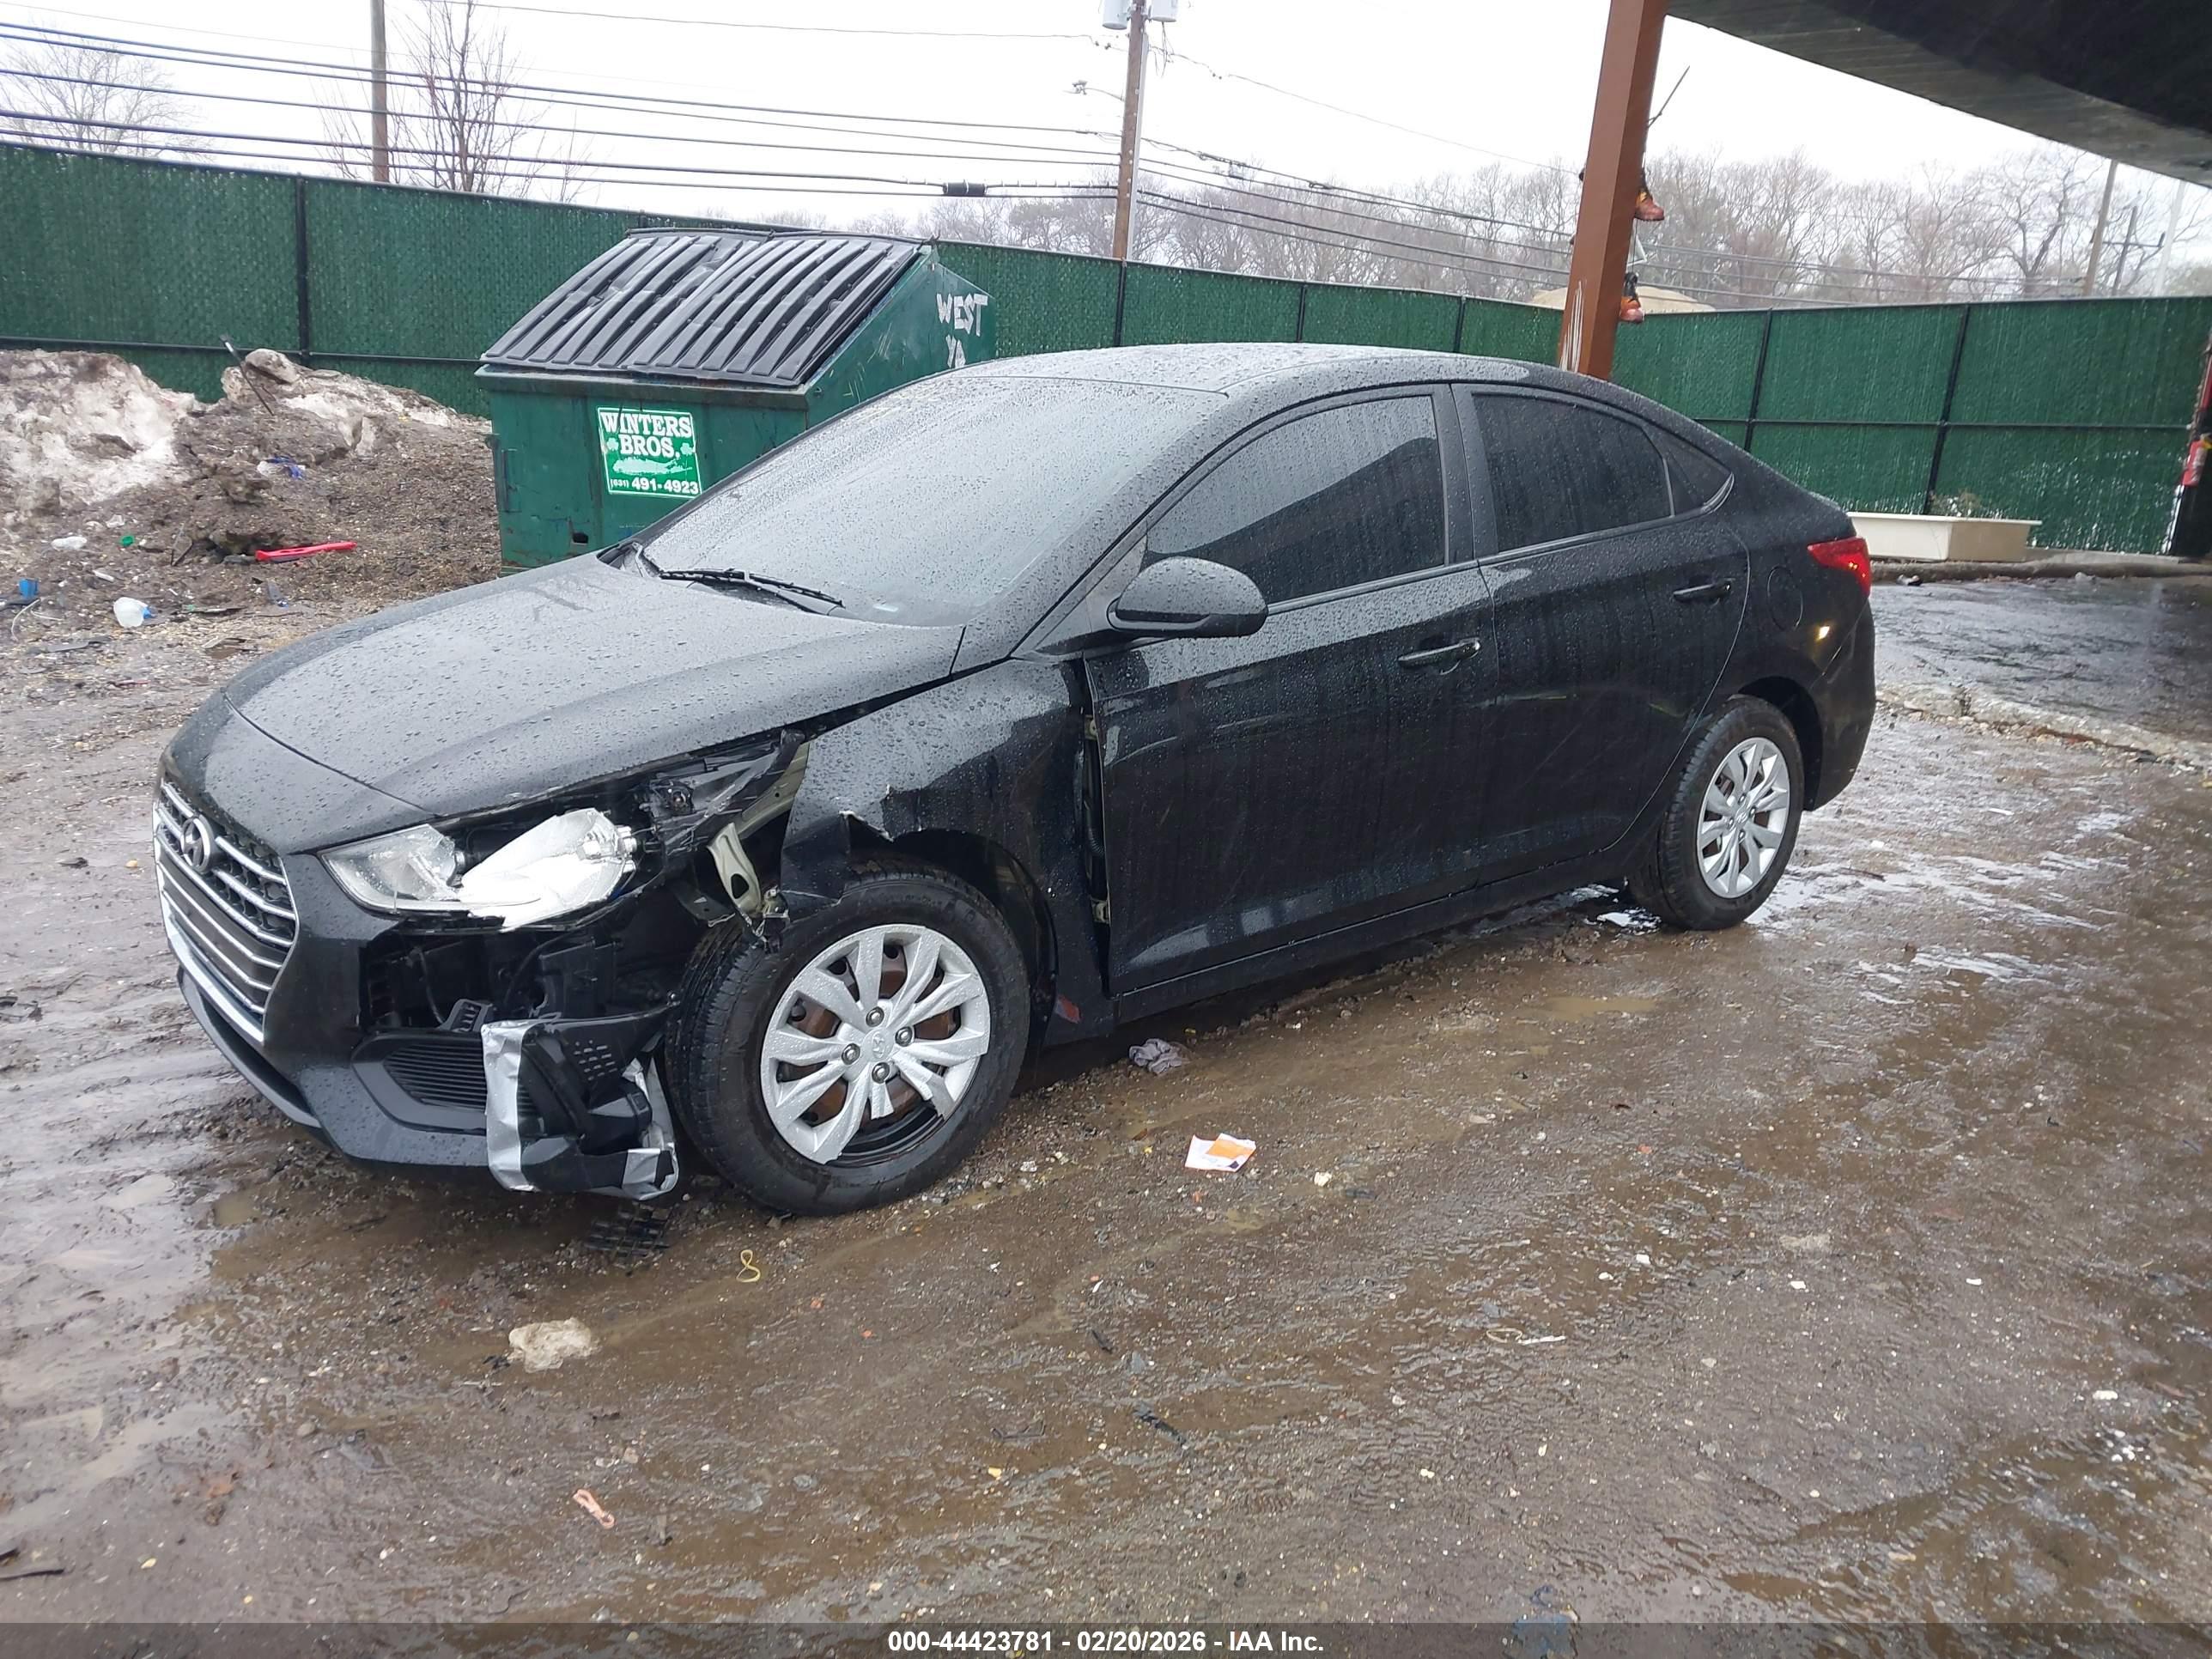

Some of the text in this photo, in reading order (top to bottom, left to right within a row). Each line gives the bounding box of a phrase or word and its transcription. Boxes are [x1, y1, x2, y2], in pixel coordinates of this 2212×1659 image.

[936, 293, 989, 337] WEST
[599, 412, 693, 438] WINTERS
[617, 434, 681, 459] BROS.
[631, 477, 699, 495] 491-4923
